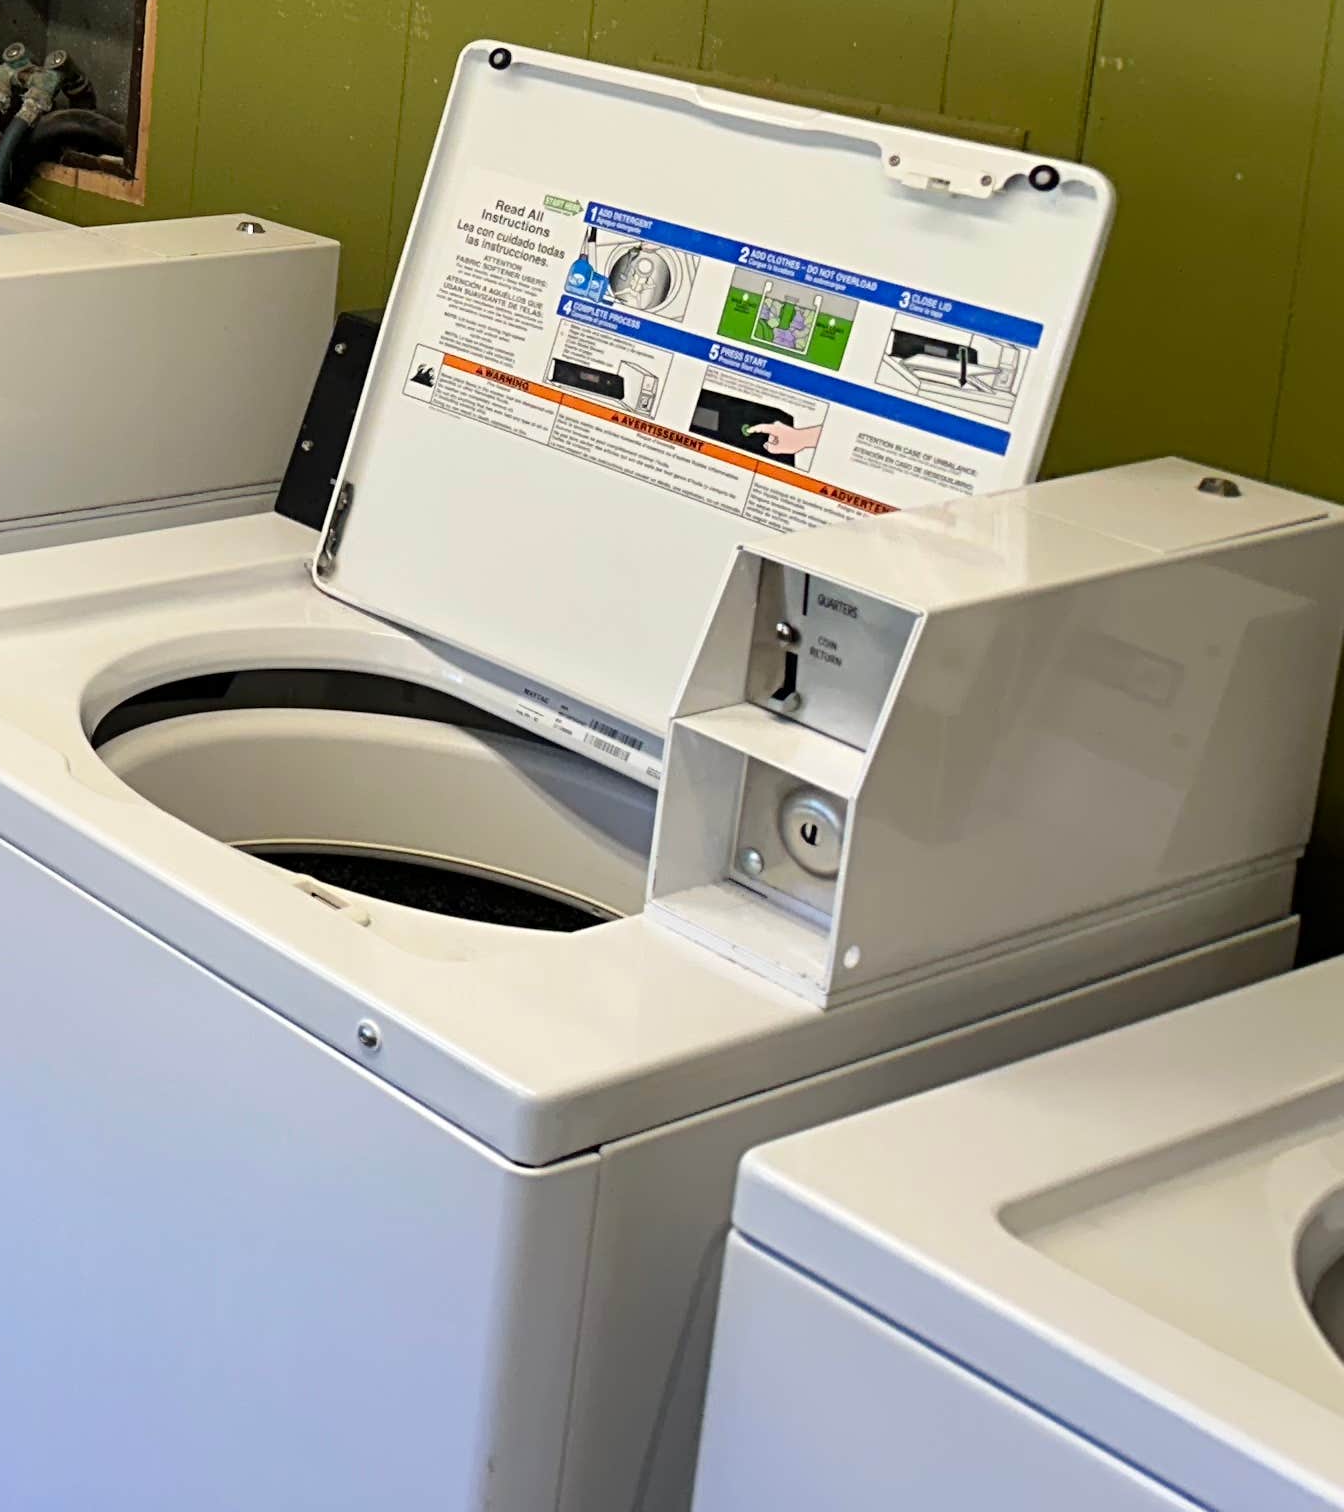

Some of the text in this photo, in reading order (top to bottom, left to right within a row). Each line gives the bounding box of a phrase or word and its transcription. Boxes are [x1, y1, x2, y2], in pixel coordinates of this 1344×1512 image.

[480, 208, 551, 238] Instructions
[495, 199, 525, 217] Read
[527, 208, 544, 222] All
[588, 205, 598, 221] 1
[598, 207, 613, 218] ADD
[612, 211, 653, 229] DETERGENT
[456, 218, 566, 259] Lea con cuidado todas
[464, 233, 550, 268] las instrucciones.
[455, 254, 481, 267] FABRIC
[482, 262, 520, 279] SOFTENER
[483, 254, 522, 272] ATTENTION
[737, 245, 751, 264] 2
[750, 249, 766, 260] ADD
[766, 253, 801, 270] CLOTHES
[805, 264, 818, 275] DO
[818, 267, 835, 279] NOT
[834, 272, 878, 291] OVERLOAD
[507, 301, 517, 310] DE
[527, 299, 543, 310] QUE
[561, 298, 641, 329] 4 COMPLETE PROCESS
[897, 290, 953, 312] 3 CLOSE LID
[707, 342, 767, 368] 5 PRESS START
[484, 368, 530, 391] WARNING
[620, 415, 704, 451] AVERTISSEMENT
[902, 446, 921, 457] CASE
[817, 593, 858, 619] QUARTERS
